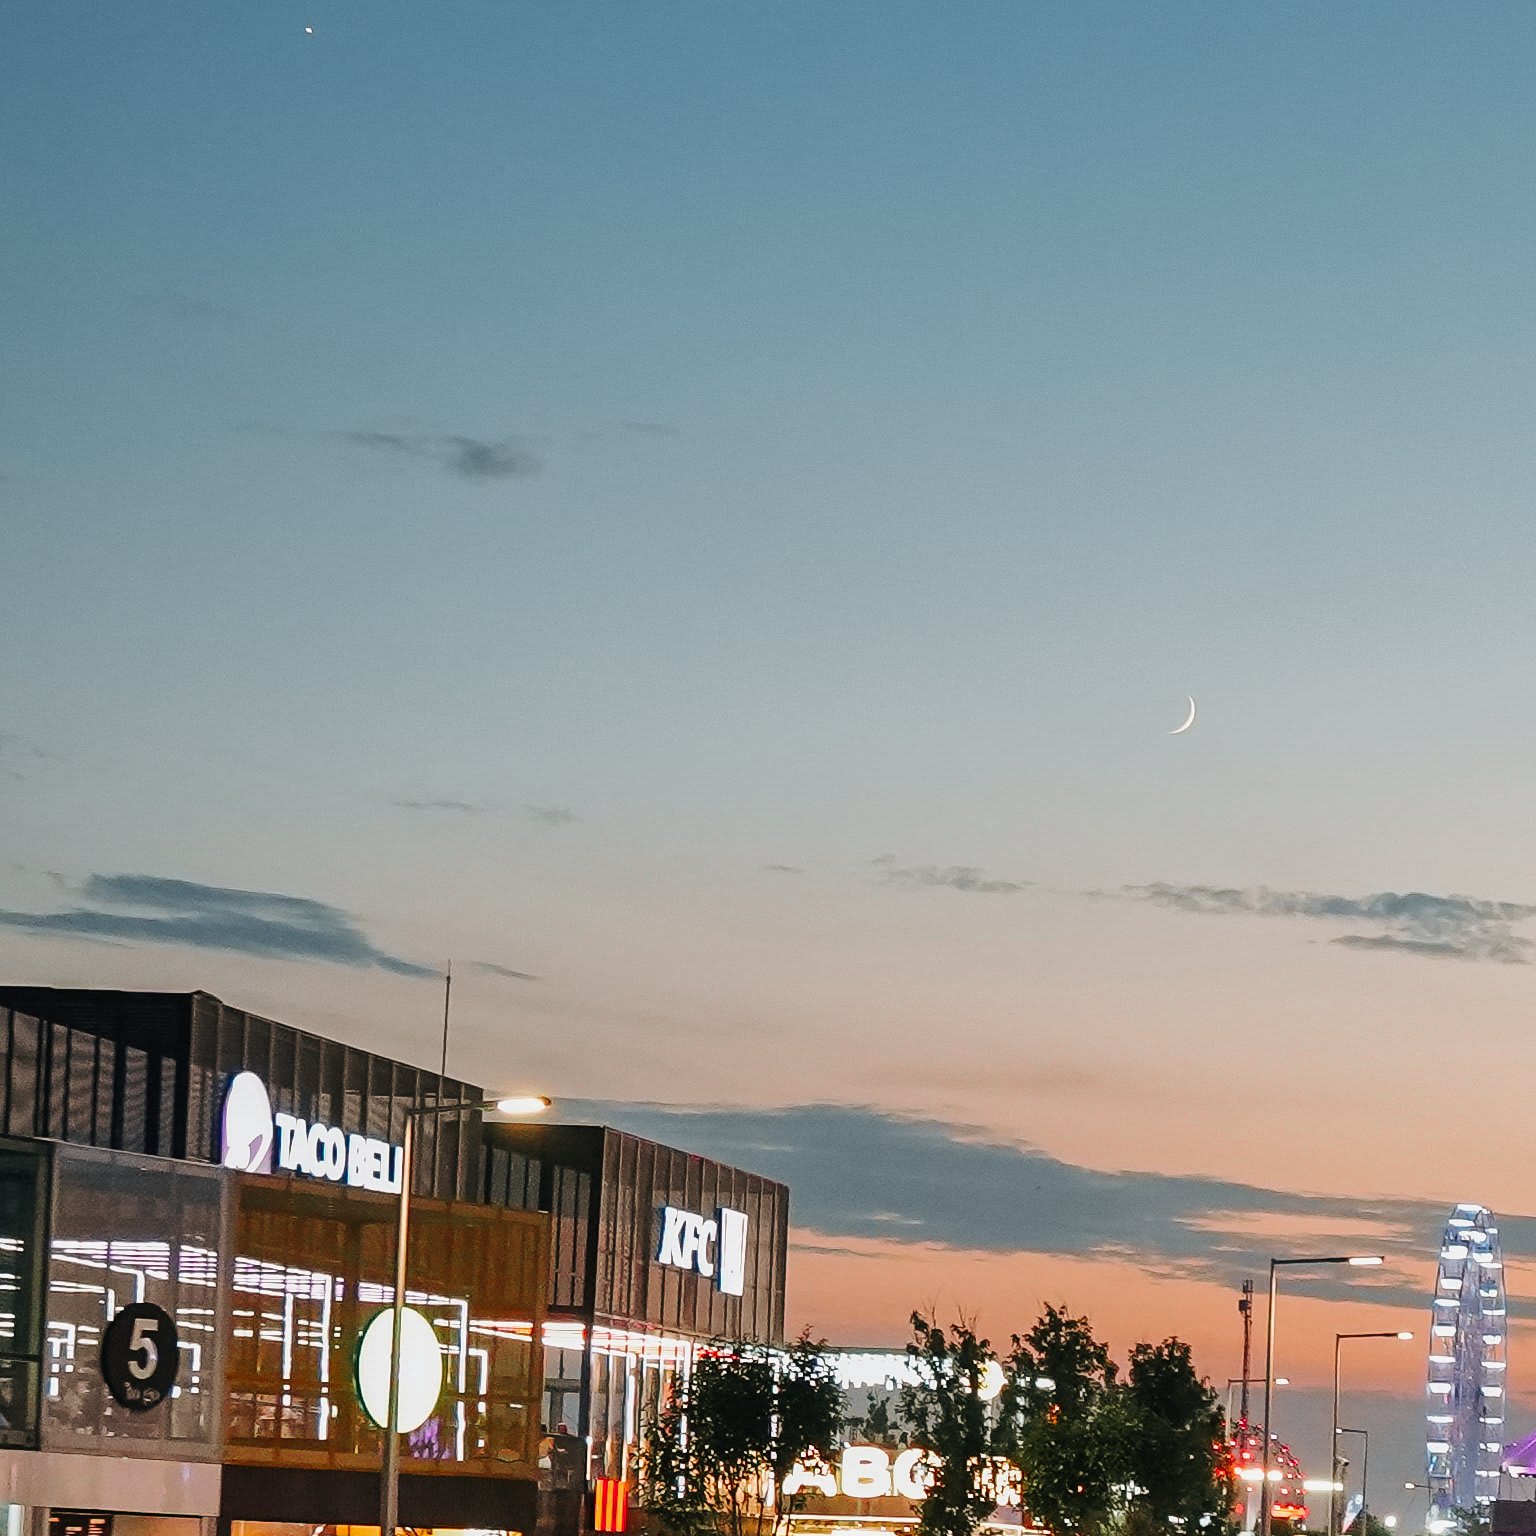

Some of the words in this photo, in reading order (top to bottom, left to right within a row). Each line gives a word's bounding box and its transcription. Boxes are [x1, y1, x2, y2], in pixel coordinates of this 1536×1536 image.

[276, 1112, 346, 1181] TACO
[658, 1206, 718, 1277] KFC
[128, 1318, 158, 1380] 5
